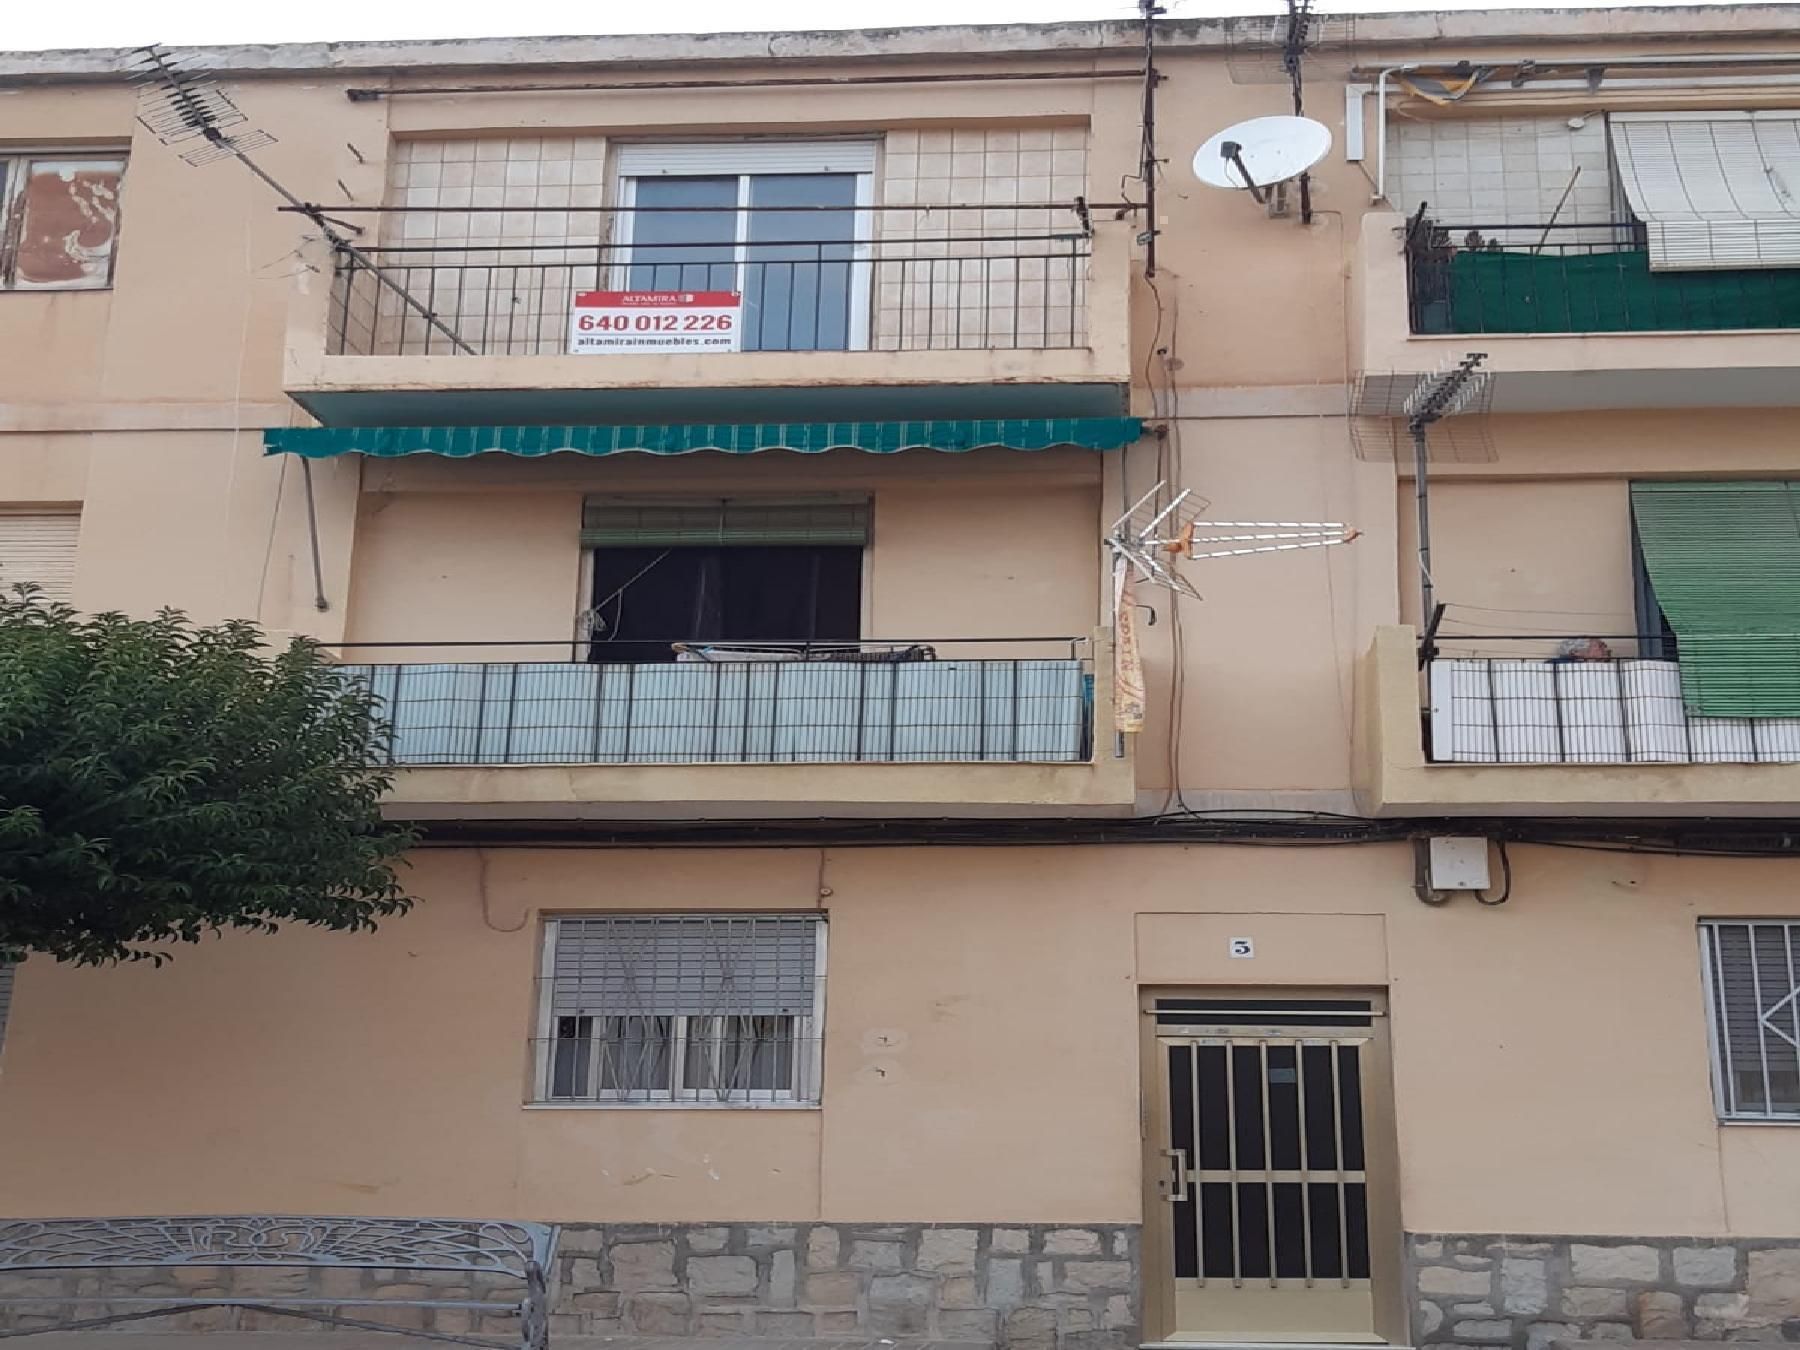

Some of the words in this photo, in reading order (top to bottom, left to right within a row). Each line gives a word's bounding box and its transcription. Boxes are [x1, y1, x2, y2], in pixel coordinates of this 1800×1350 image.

[623, 295, 676, 303] ALTAMIRA
[579, 315, 629, 331] 640
[635, 315, 678, 331] 012
[683, 314, 732, 331] 226
[578, 337, 731, 346] altamirainmuebles.com
